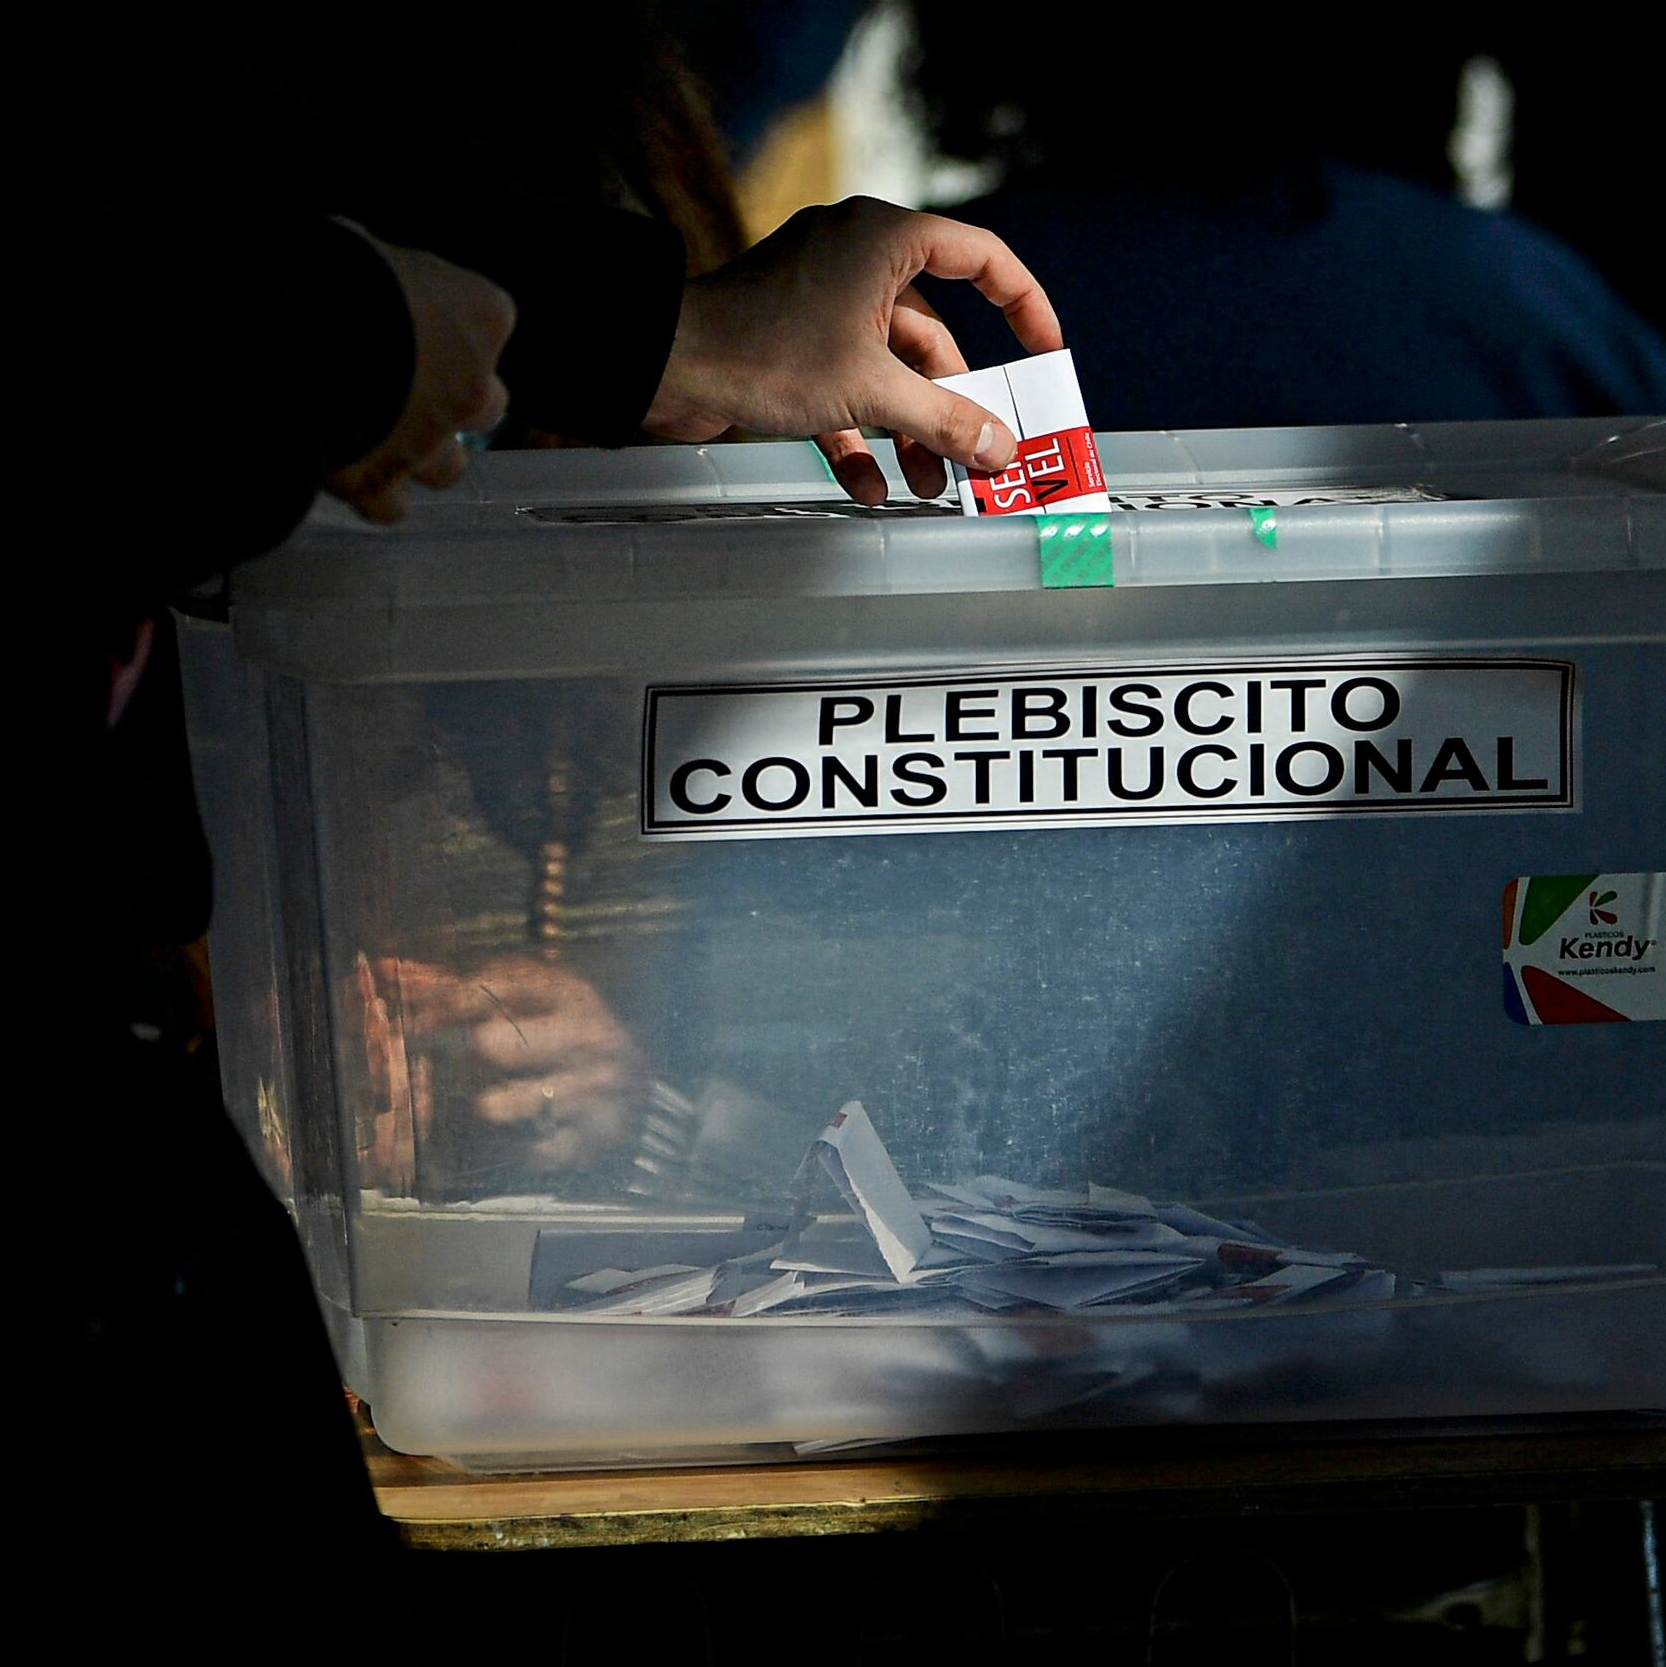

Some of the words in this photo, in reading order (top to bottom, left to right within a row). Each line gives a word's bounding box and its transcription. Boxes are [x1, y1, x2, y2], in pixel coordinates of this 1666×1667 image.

[1025, 438, 1069, 502] VEL
[817, 676, 1402, 747] PLEBISCITO
[668, 736, 1549, 815] CONSTITUCIONAL
[1558, 965, 1656, 977] www.plasticoskendy.com
[1559, 935, 1650, 961] Kendy
